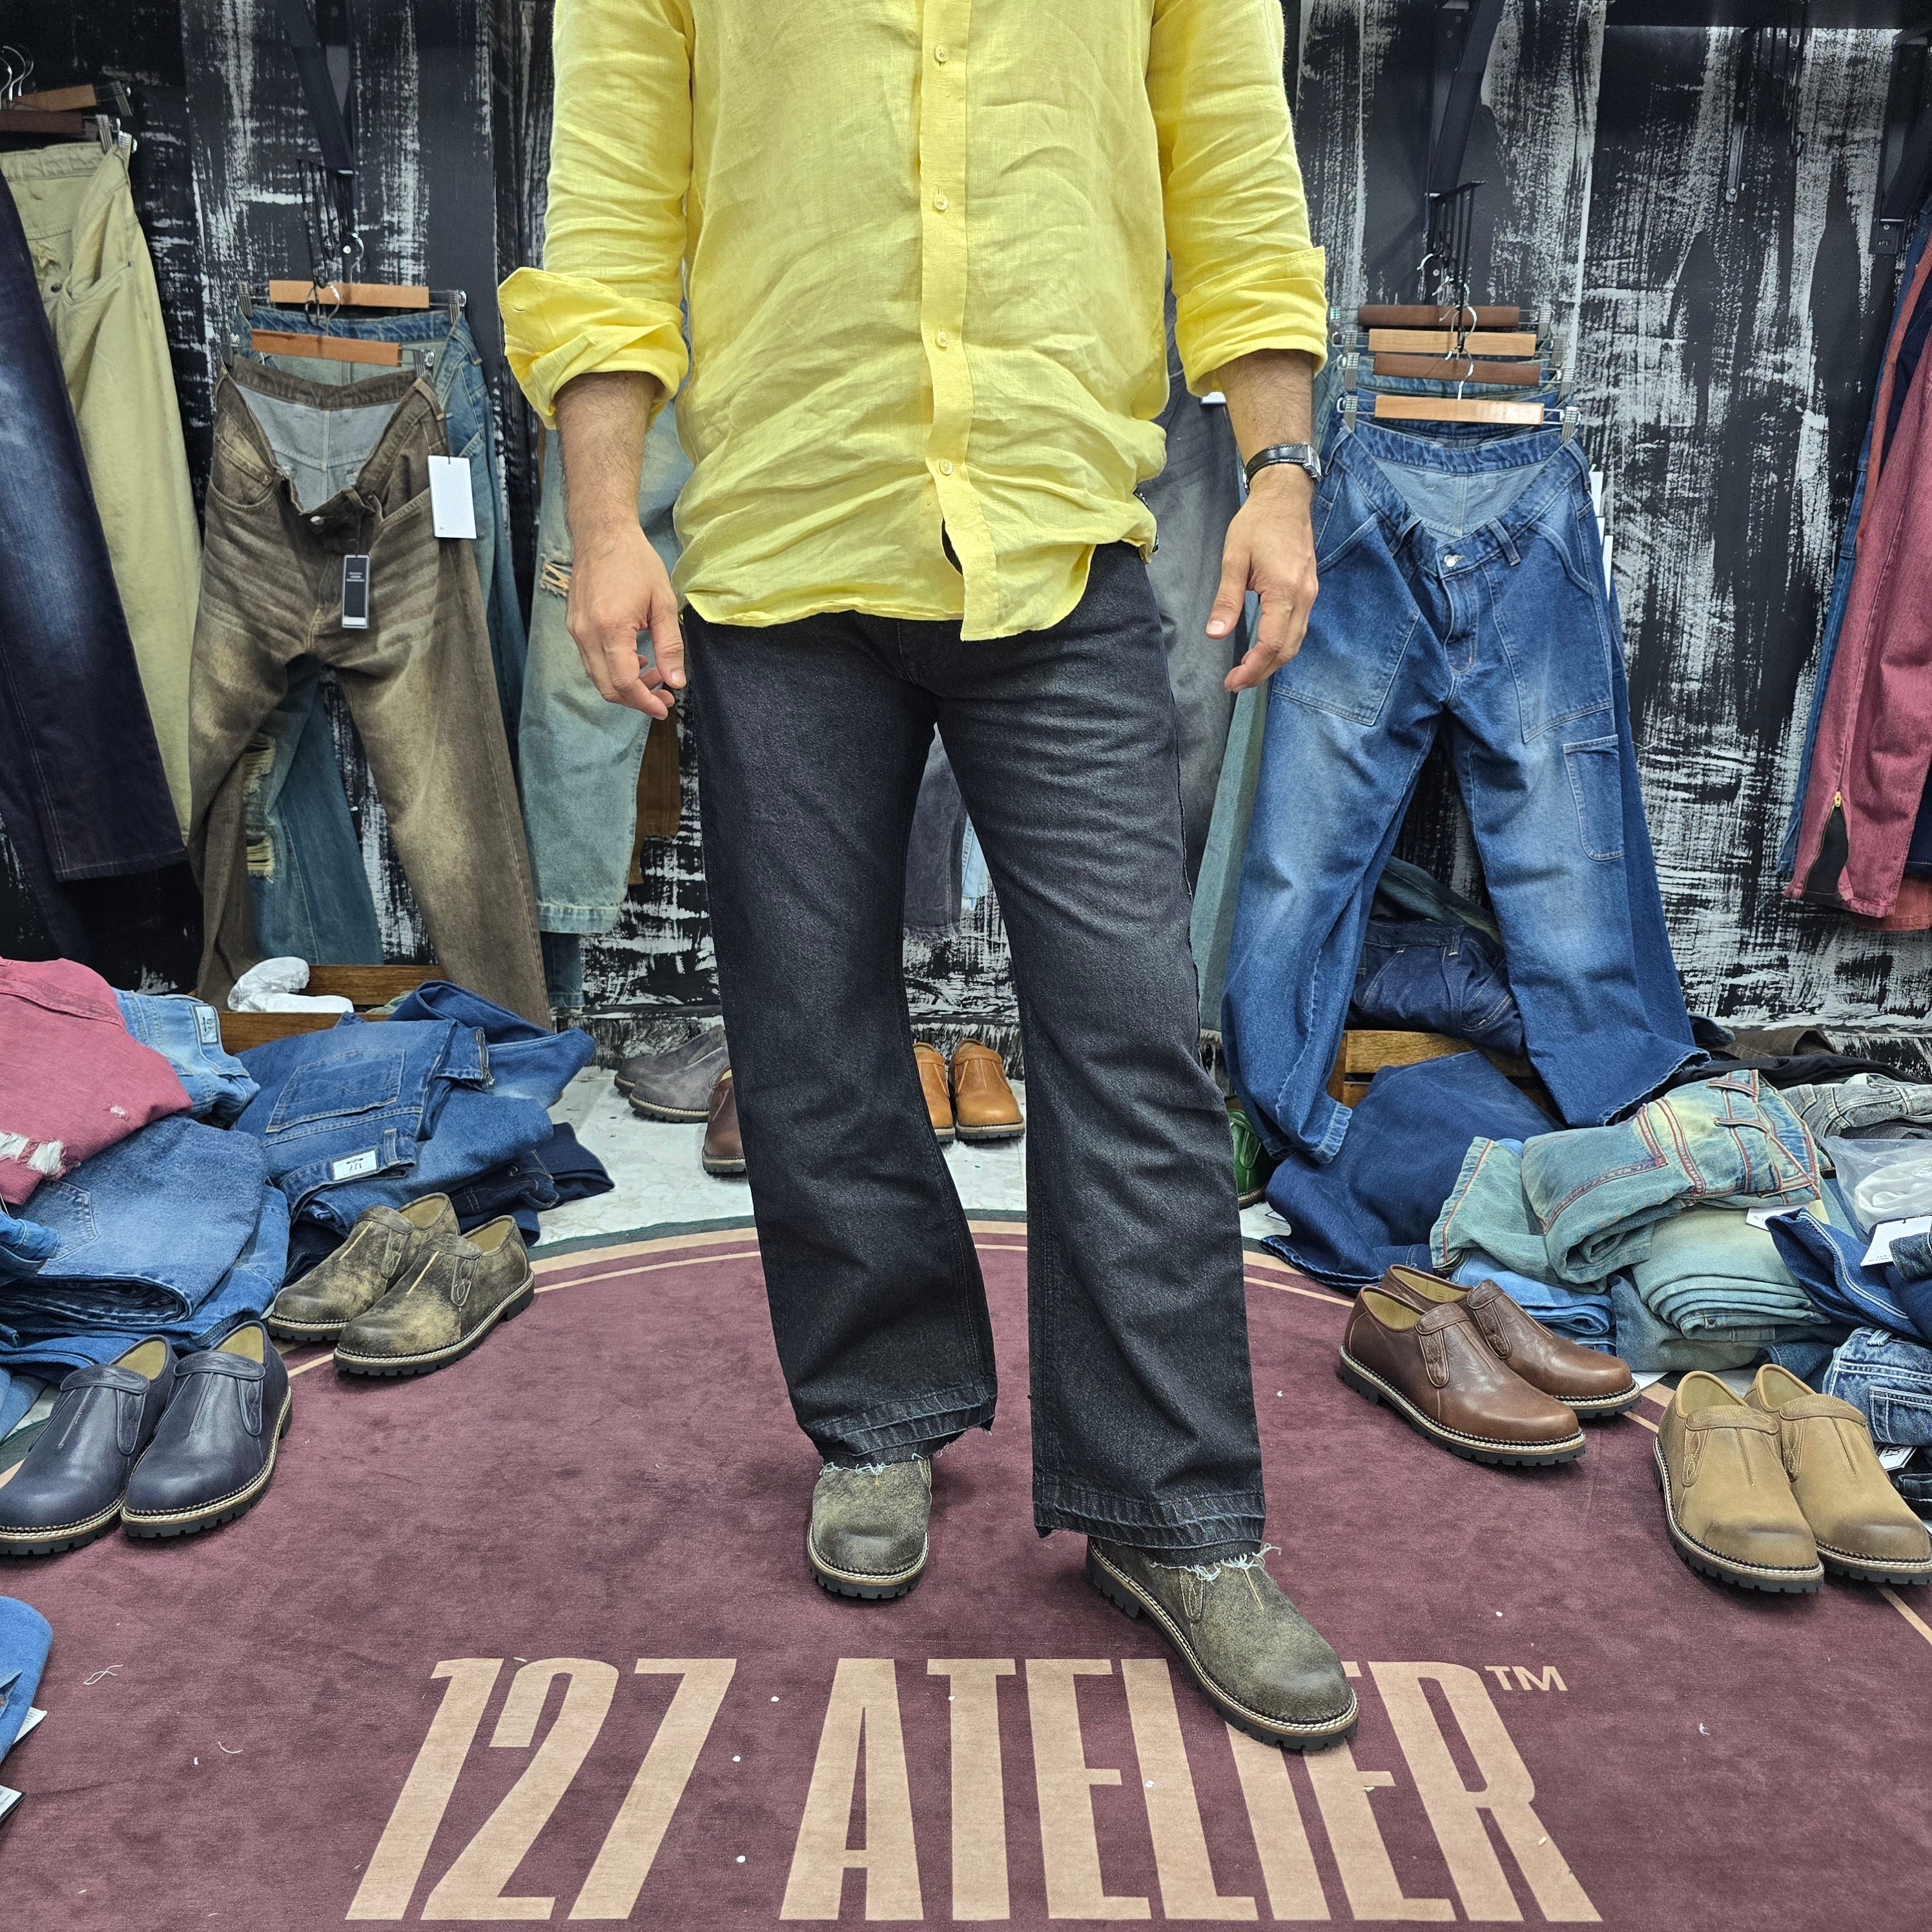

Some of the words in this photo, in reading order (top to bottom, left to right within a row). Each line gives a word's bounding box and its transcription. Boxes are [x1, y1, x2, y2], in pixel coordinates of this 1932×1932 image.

[349, 1163, 362, 1172] 127
[345, 1658, 737, 1921] 127
[779, 1658, 1603, 1922] ATELIER
